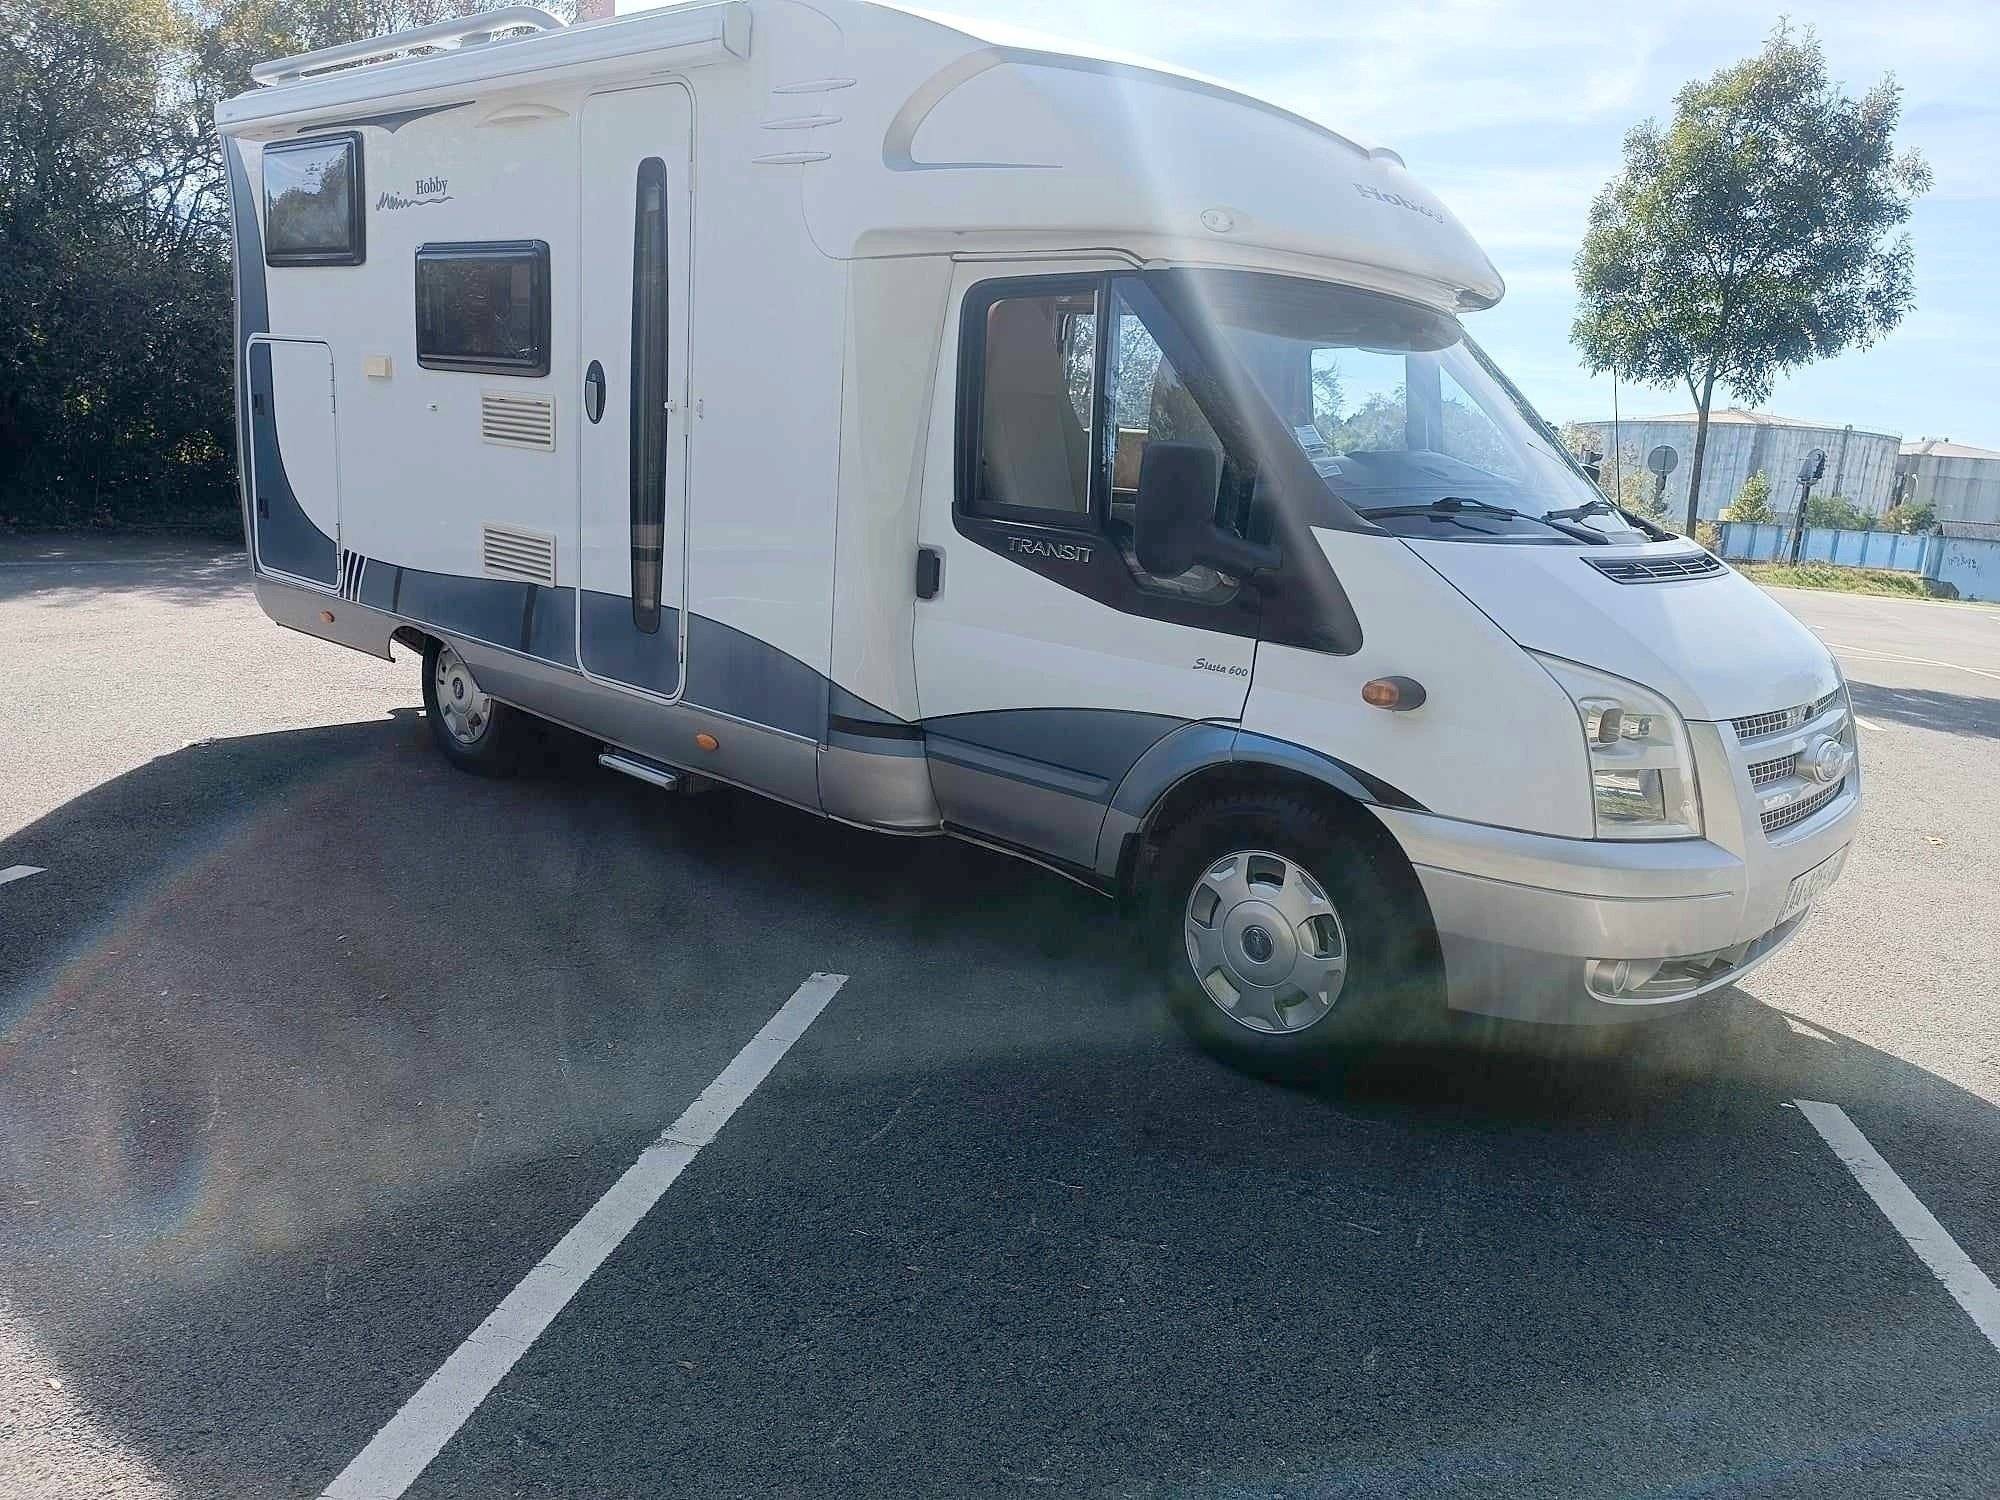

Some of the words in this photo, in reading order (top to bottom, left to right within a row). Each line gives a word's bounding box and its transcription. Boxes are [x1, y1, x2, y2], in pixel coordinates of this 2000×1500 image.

[415, 175, 448, 195] Hobby
[1008, 536, 1095, 563] TRANSIT
[1229, 665, 1248, 677] 600
